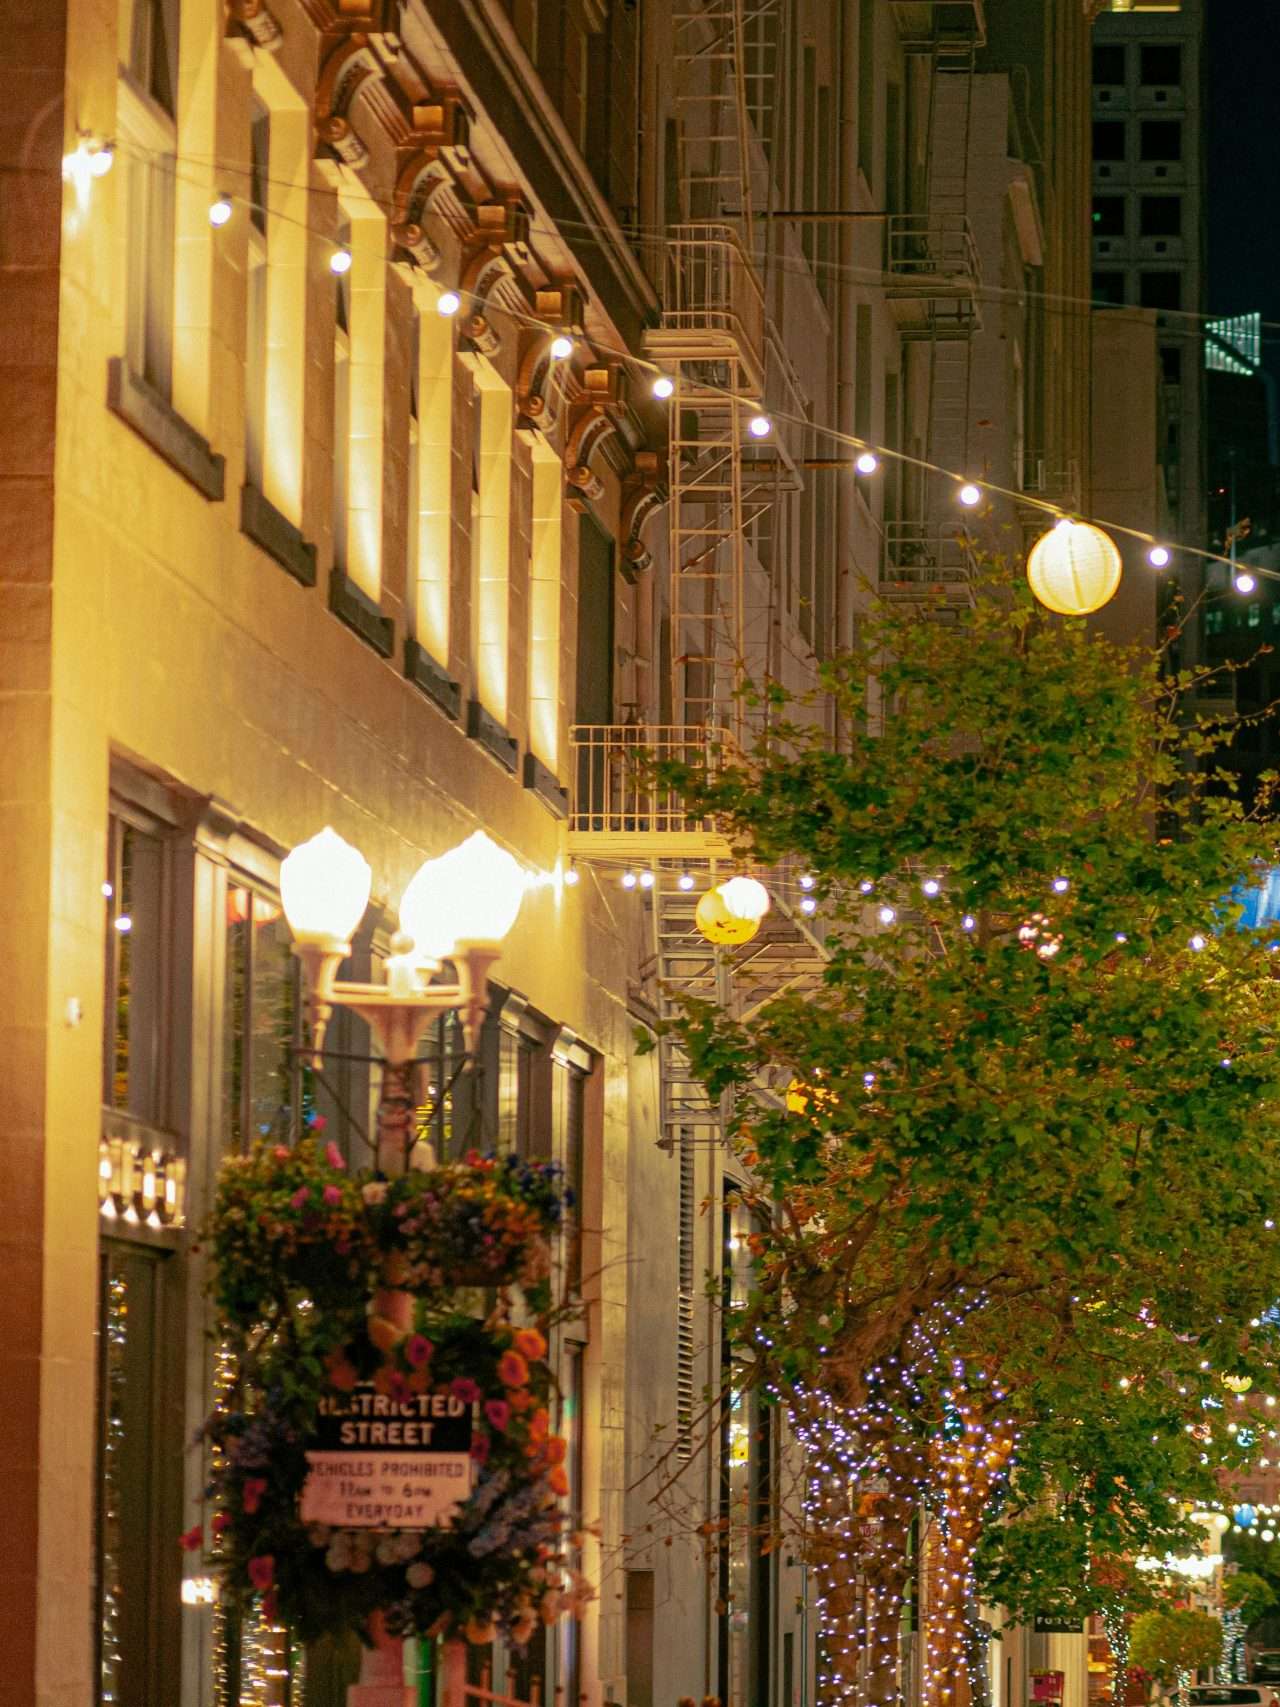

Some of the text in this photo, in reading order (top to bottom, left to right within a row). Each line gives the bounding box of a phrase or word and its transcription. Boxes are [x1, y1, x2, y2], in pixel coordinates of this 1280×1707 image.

[339, 1420, 436, 1446] STREET
[381, 1462, 464, 1478] PROHIBITED
[346, 1504, 424, 1519] EVERYDAY
